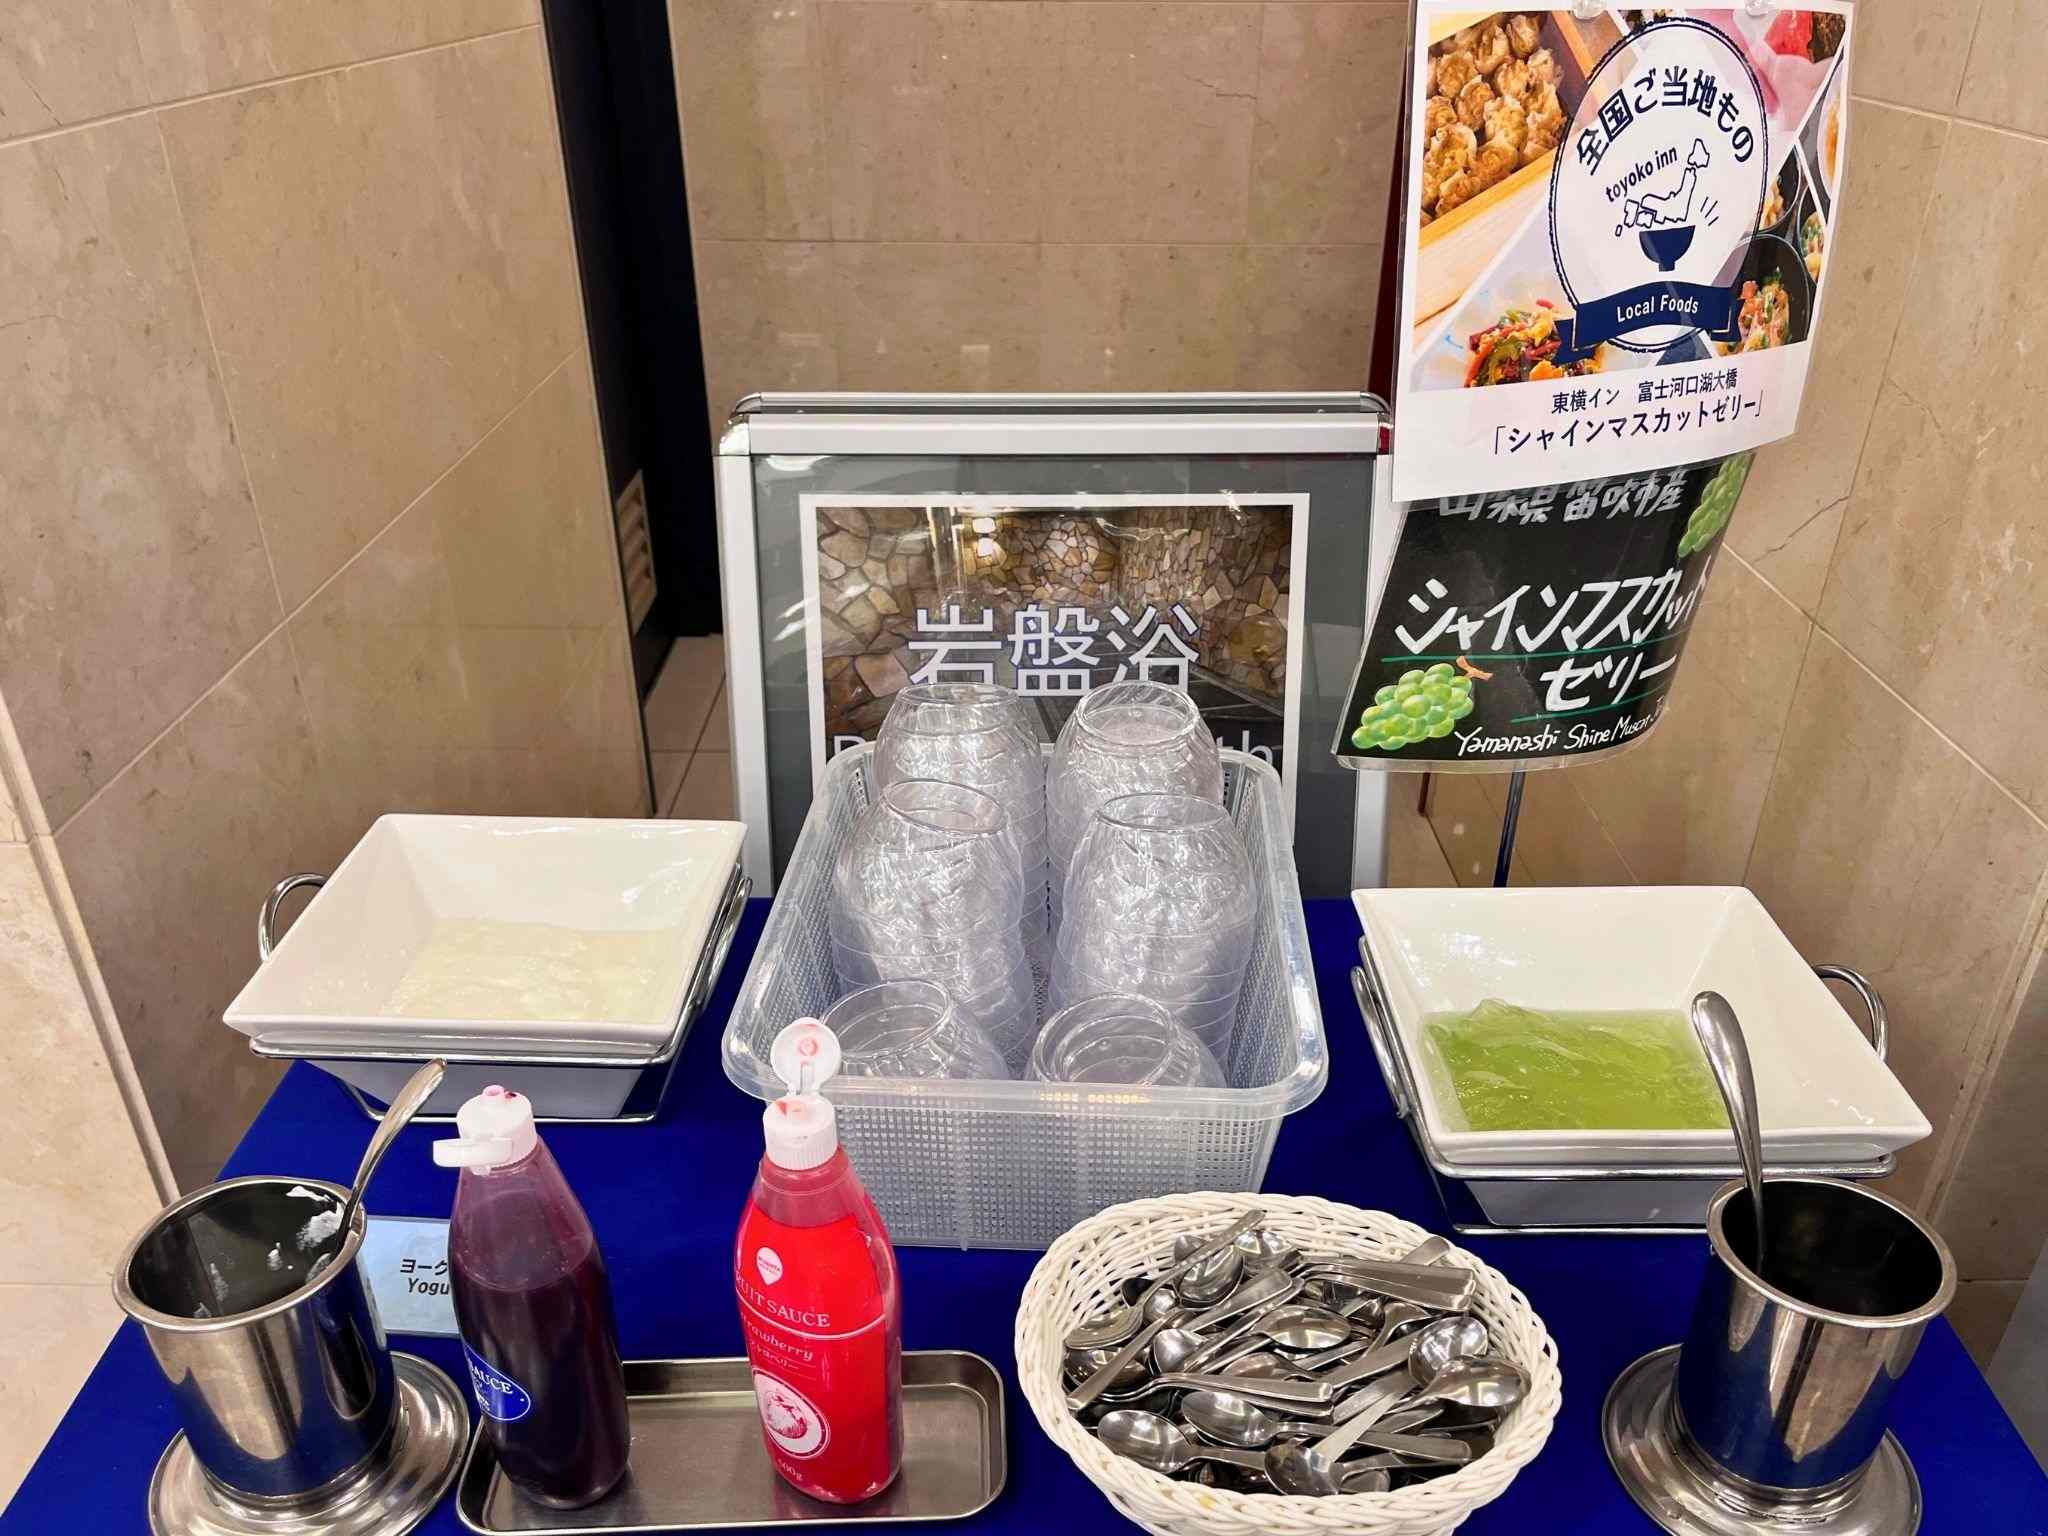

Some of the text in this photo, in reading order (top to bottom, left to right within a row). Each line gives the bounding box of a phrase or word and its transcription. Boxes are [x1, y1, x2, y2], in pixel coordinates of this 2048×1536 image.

[1577, 65, 1754, 175] 全国ご当地もの
[1605, 147, 1679, 203] toyoko inn
[1616, 294, 1699, 323] Local Foods
[1552, 367, 1739, 415] 東横イン 富士河口湖大橋
[1494, 390, 1764, 456] 「シャインマスカットゼリー」
[907, 603, 1201, 698] 岩盤浴
[1540, 653, 1677, 712] ゼリー
[1454, 724, 1560, 758] Yamanashi
[1563, 723, 1611, 751] Shine
[766, 1299, 831, 1328] SAUCE
